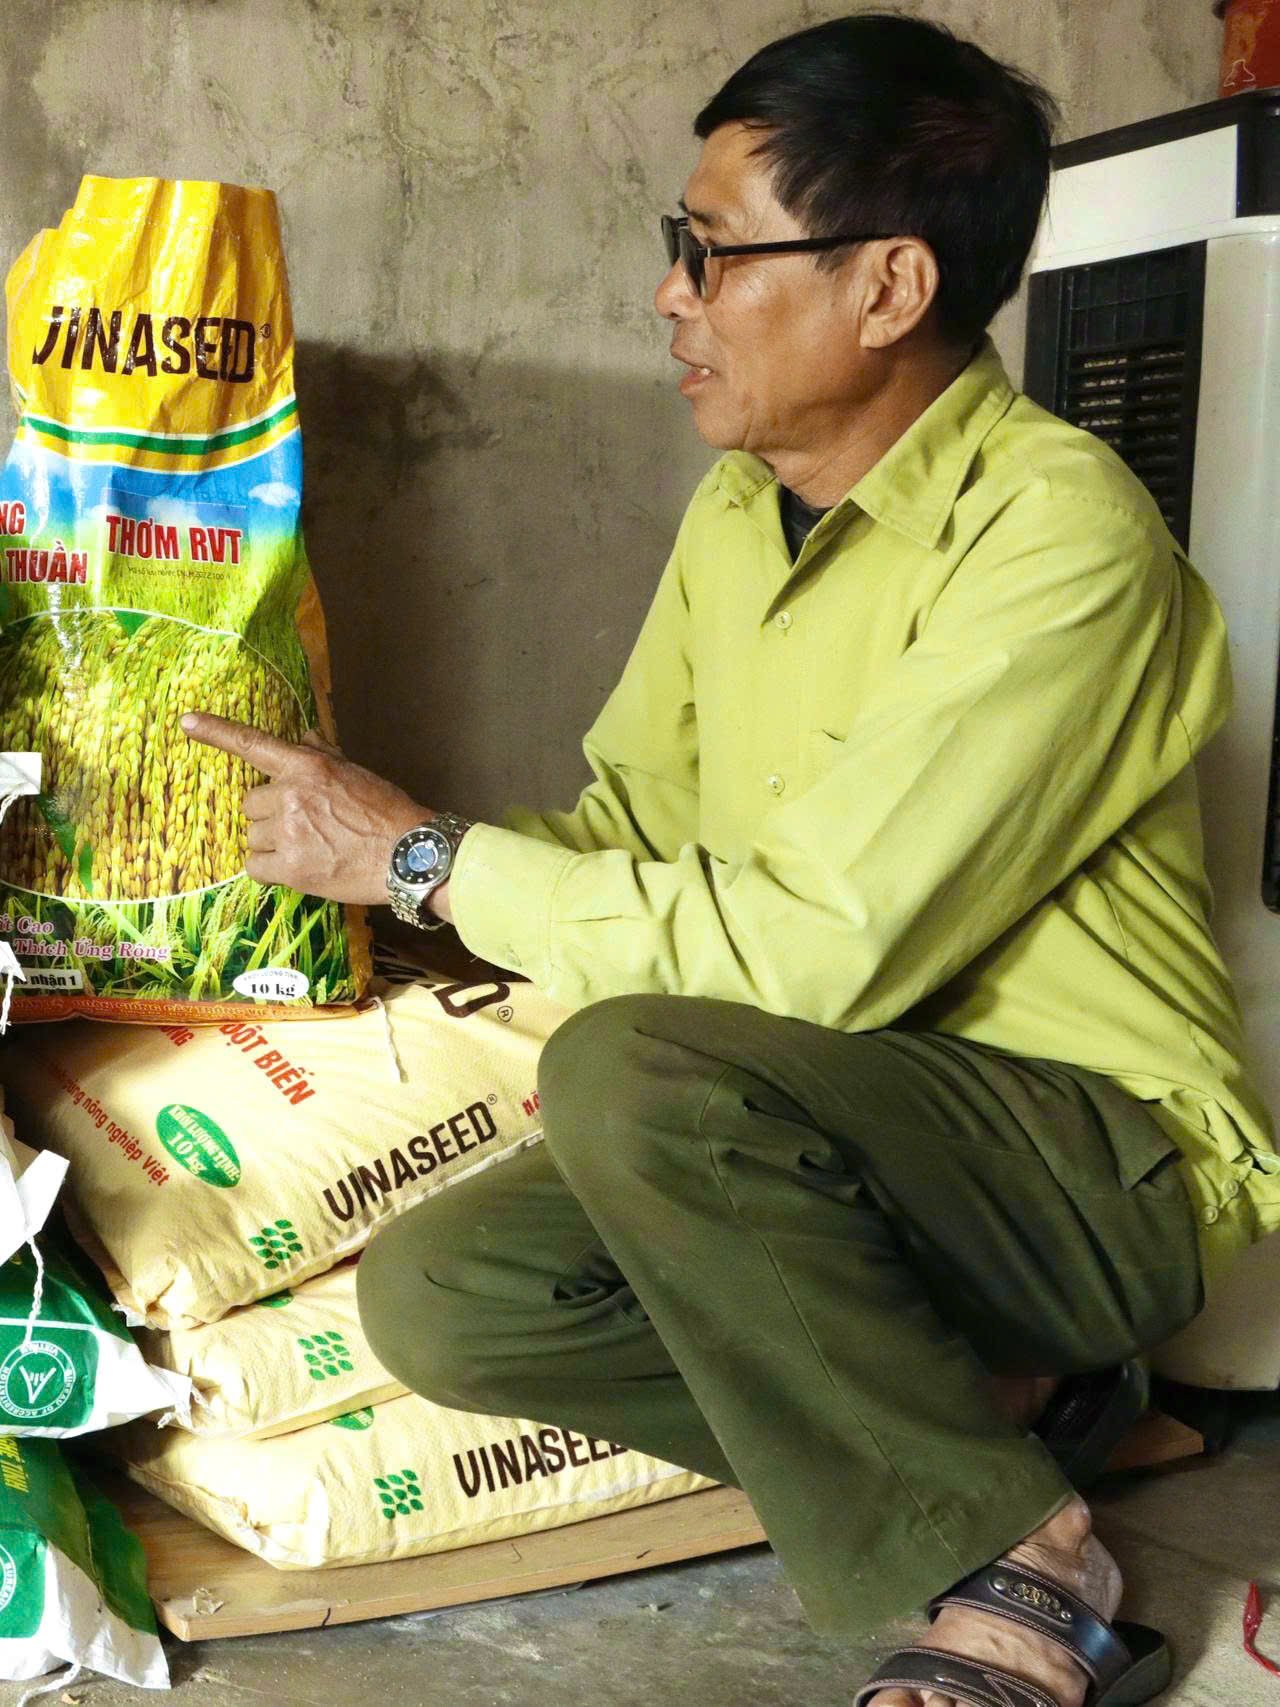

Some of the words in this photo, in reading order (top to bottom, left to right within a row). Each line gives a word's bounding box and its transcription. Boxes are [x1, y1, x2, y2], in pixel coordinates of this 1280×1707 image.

[106, 514, 179, 560] THƠM
[190, 527, 242, 564] RVT
[5, 540, 88, 584] THUẦN
[17, 916, 55, 934] Cao
[13, 939, 68, 957] Thích
[74, 936, 114, 960] Ứng
[119, 942, 169, 962] Rộng
[31, 974, 66, 989] nhận
[70, 976, 76, 986] 1
[251, 983, 269, 994] 10
[276, 983, 296, 997] kg
[254, 1050, 316, 1105] BIẾN
[105, 1120, 144, 1161] nghiệp
[142, 1155, 170, 1187] Việt
[167, 1132, 193, 1155] 10
[322, 1101, 498, 1222] VINASEED
[453, 1427, 628, 1499] VINASEE
